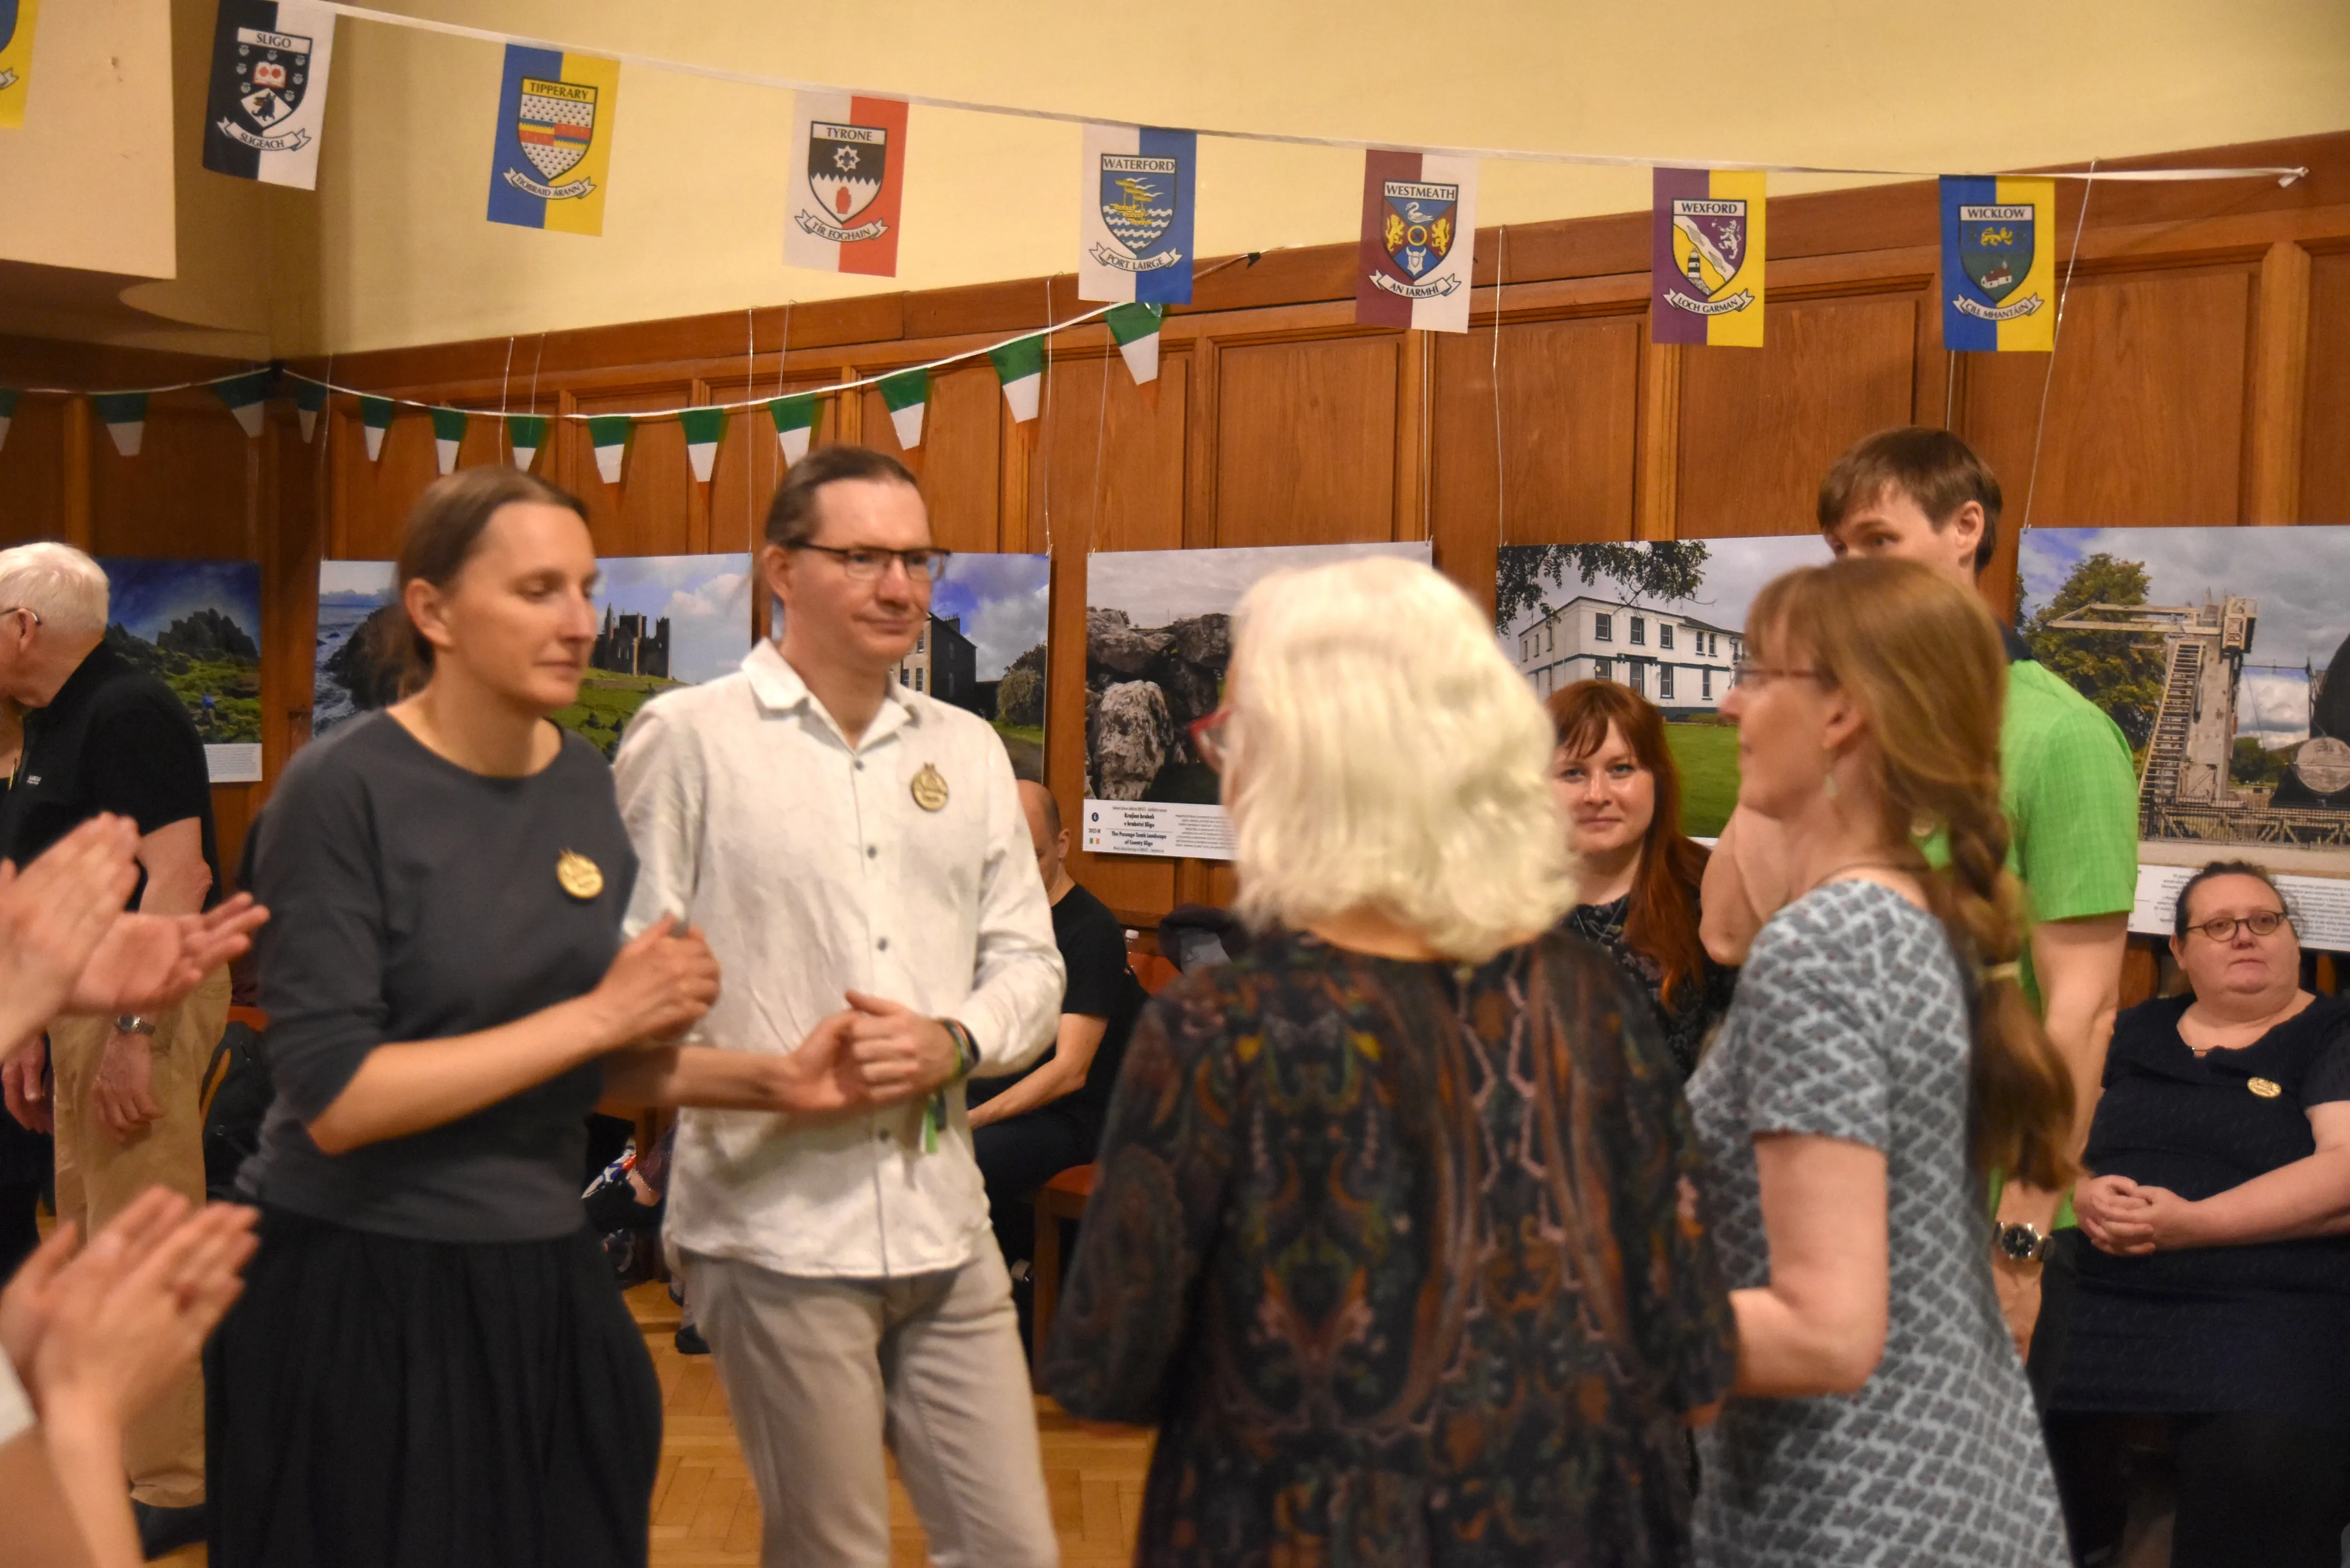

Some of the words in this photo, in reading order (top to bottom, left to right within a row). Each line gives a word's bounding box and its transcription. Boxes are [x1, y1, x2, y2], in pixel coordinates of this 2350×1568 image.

[256, 33, 291, 48] SLIGO
[530, 82, 590, 99] TIPPERARY
[239, 133, 285, 148] SLIGEACH
[826, 127, 872, 141] TYRONE
[1103, 158, 1174, 171] WATERFORD
[515, 176, 551, 196] TIOBRAID
[1386, 185, 1455, 199] WESTMEATH
[1681, 202, 1737, 214] WEXFORD
[1967, 208, 2025, 218] WICKLOW
[829, 228, 871, 240] EOGHAIN
[1107, 253, 1130, 269] PORT
[1389, 283, 1403, 294] AN
[1677, 296, 1700, 311] LOCH
[1702, 299, 1738, 314] GARMAN
[1965, 303, 1980, 315] CILL
